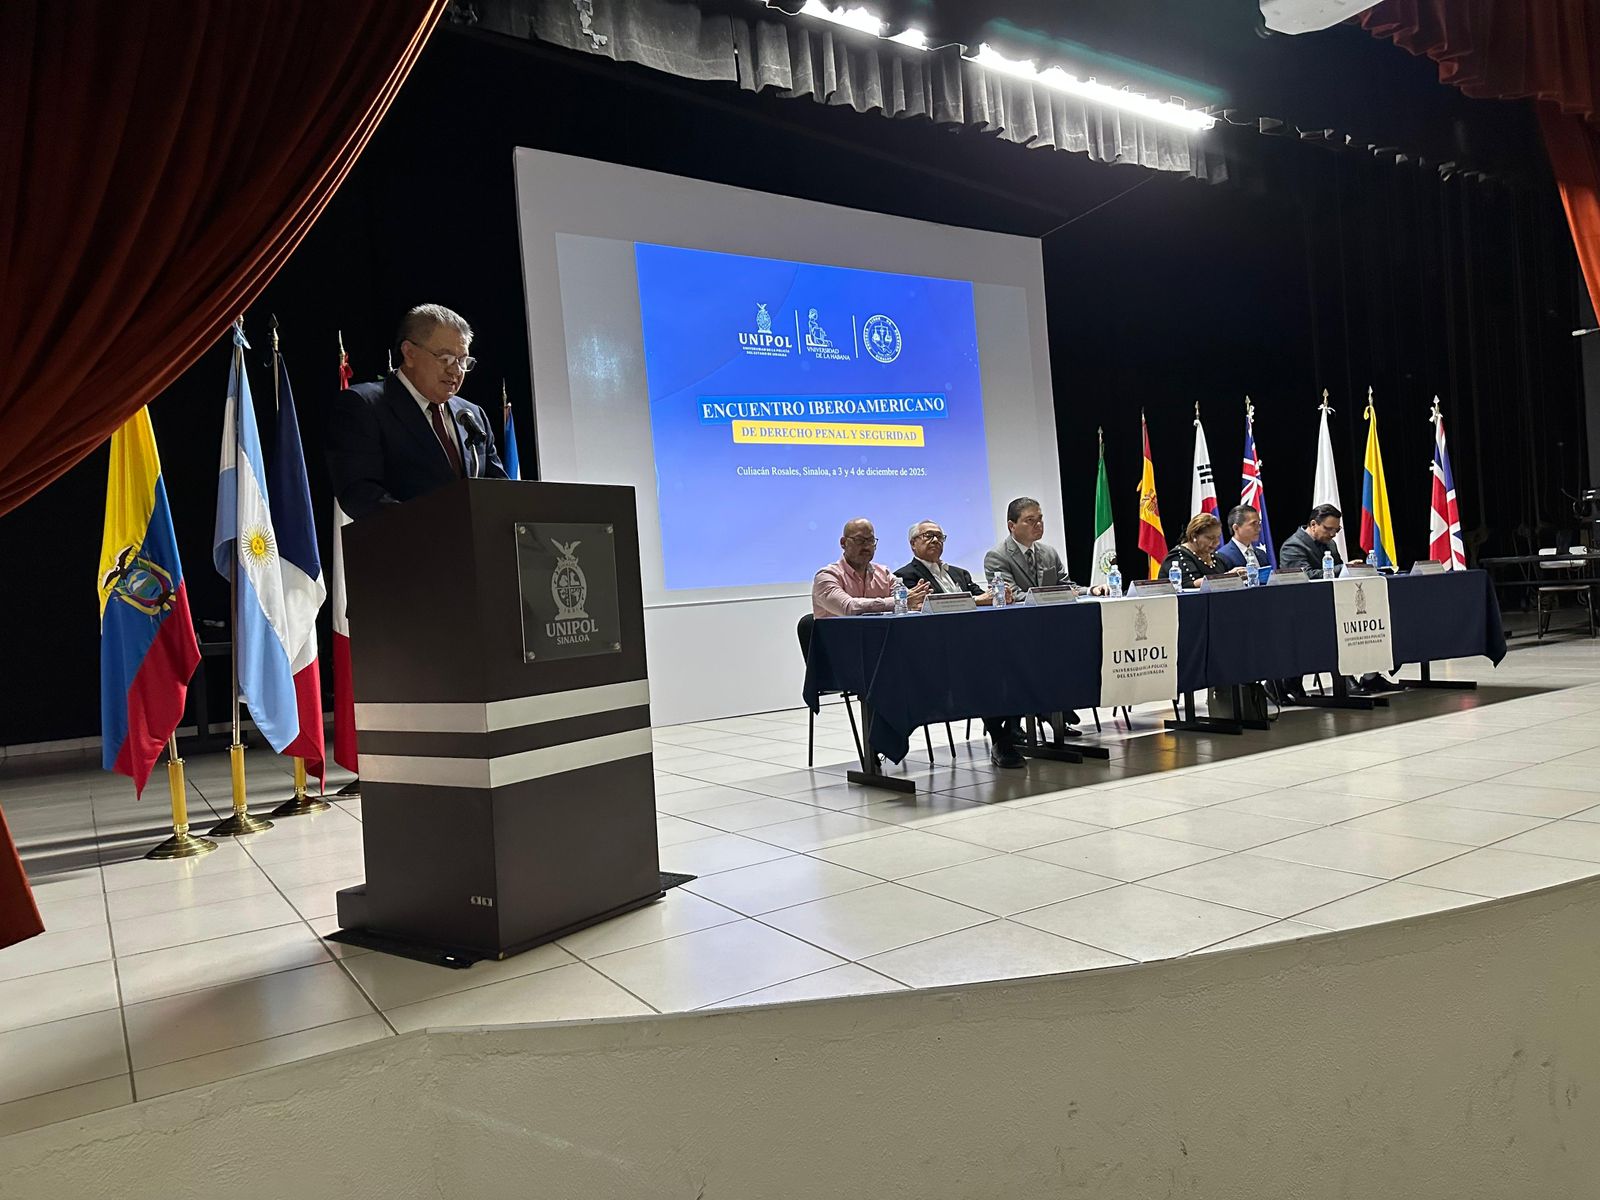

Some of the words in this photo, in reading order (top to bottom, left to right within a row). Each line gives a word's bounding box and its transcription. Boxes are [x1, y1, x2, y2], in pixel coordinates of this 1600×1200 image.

[738, 332, 793, 348] UNIPOL
[702, 401, 805, 419] ENCUENTRO
[808, 397, 945, 415] IBEROAMERICANO
[741, 426, 757, 437] DE
[760, 427, 813, 438] DERECHO
[815, 428, 849, 439] PENAL
[850, 430, 857, 439] Y
[859, 430, 917, 441] SEGURIDAD
[736, 466, 770, 476] Culiacán
[771, 466, 802, 477] Rosales,
[802, 466, 832, 477] Sinaloa,
[837, 467, 843, 476] 3
[844, 469, 849, 478] y
[850, 467, 855, 476] 4
[856, 467, 865, 476] de
[865, 467, 899, 476] diciembre
[899, 467, 908, 476] de
[908, 467, 927, 476] 2025.
[545, 619, 599, 637] UNIPOL
[1343, 618, 1385, 634] UNIPOL
[556, 634, 590, 646] SINALOA
[1113, 646, 1168, 664] UNIPOL
